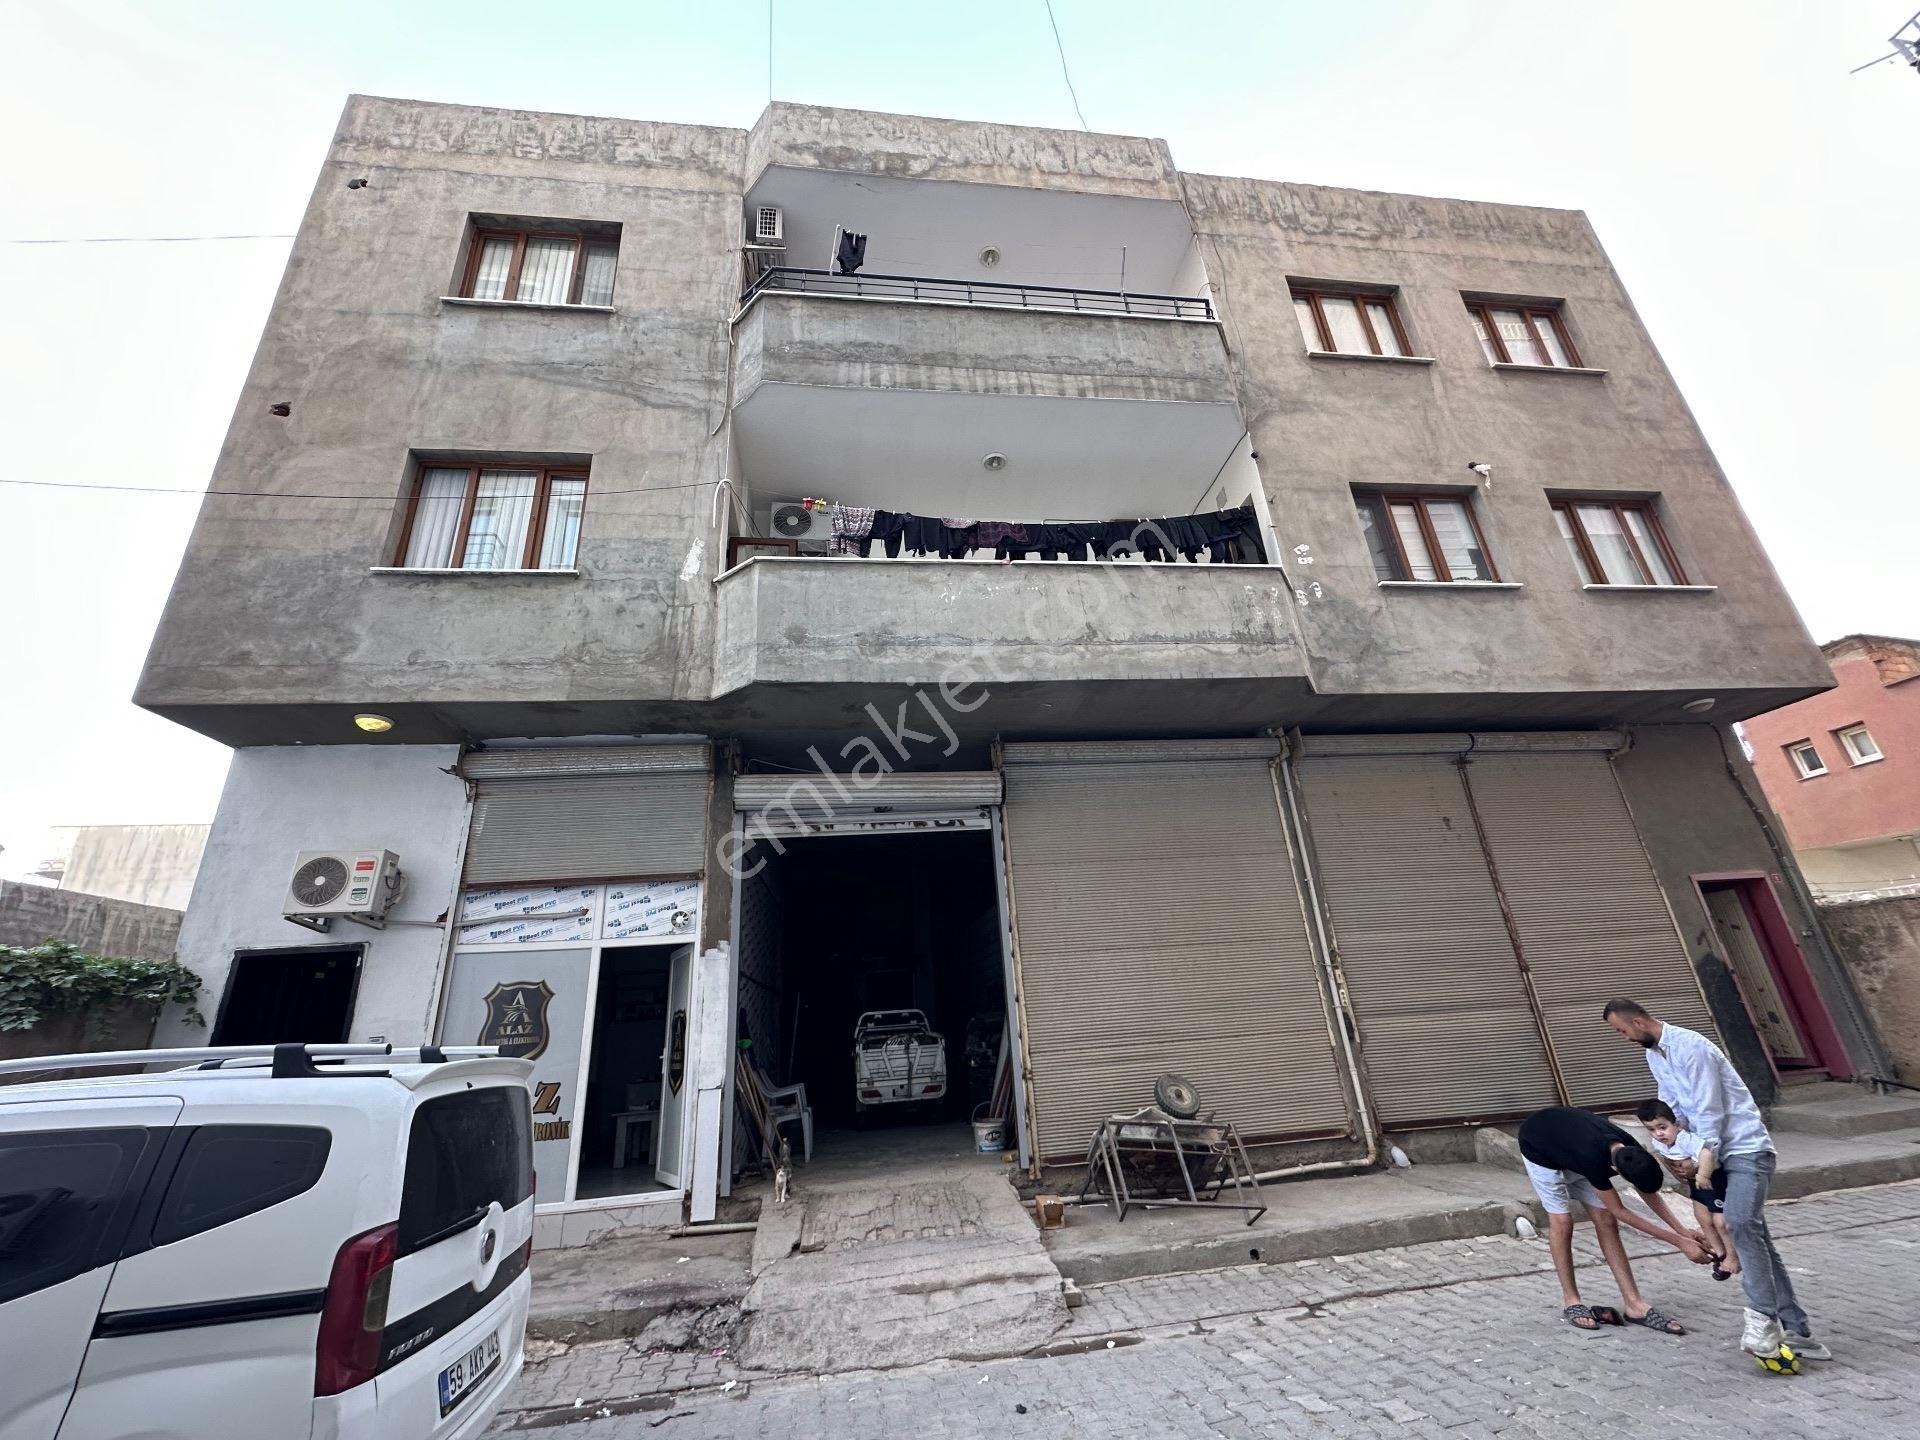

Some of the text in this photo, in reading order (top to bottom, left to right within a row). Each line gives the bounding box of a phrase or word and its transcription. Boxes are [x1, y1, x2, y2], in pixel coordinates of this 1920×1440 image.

[495, 1024, 534, 1036] ALAZ
[449, 1363, 464, 1396] 59
[469, 1345, 485, 1381] AKR
